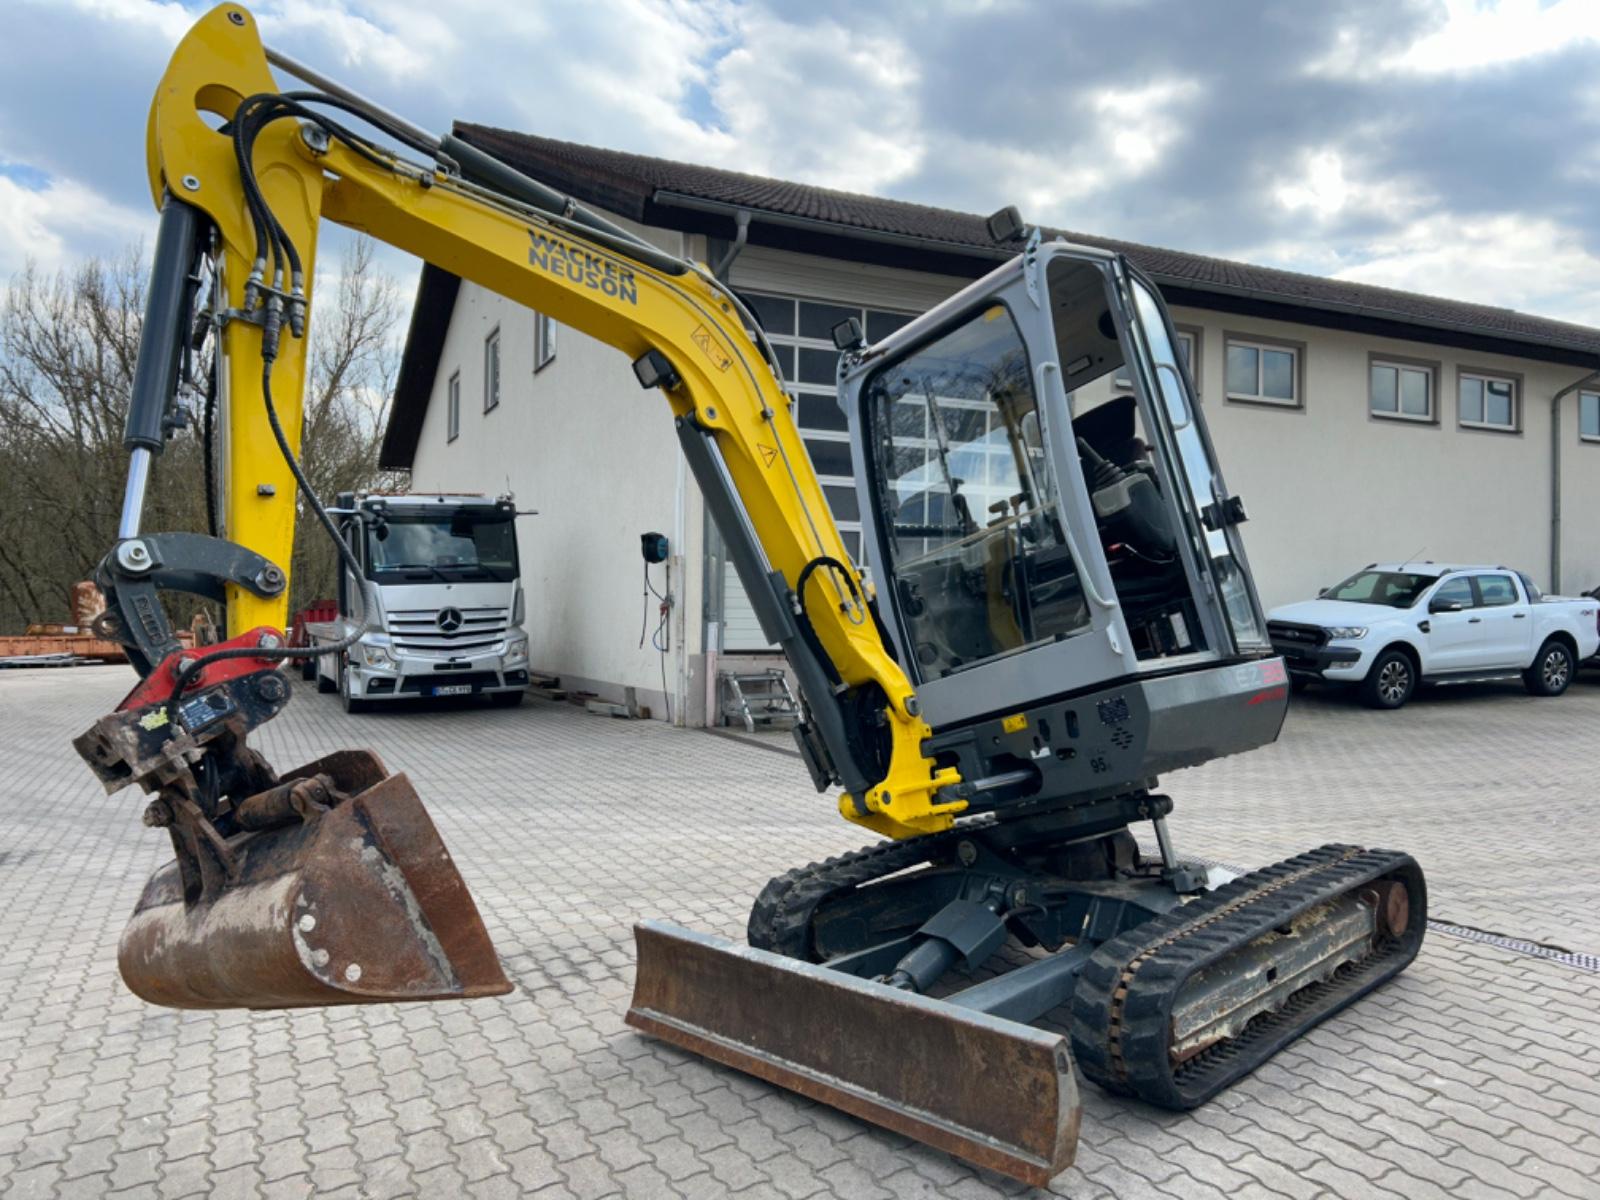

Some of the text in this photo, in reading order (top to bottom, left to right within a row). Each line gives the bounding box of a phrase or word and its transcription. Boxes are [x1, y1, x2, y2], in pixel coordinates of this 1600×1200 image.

[527, 228, 637, 288] WACKER
[528, 247, 638, 305] NEUSON
[1090, 757, 1107, 774] 95
